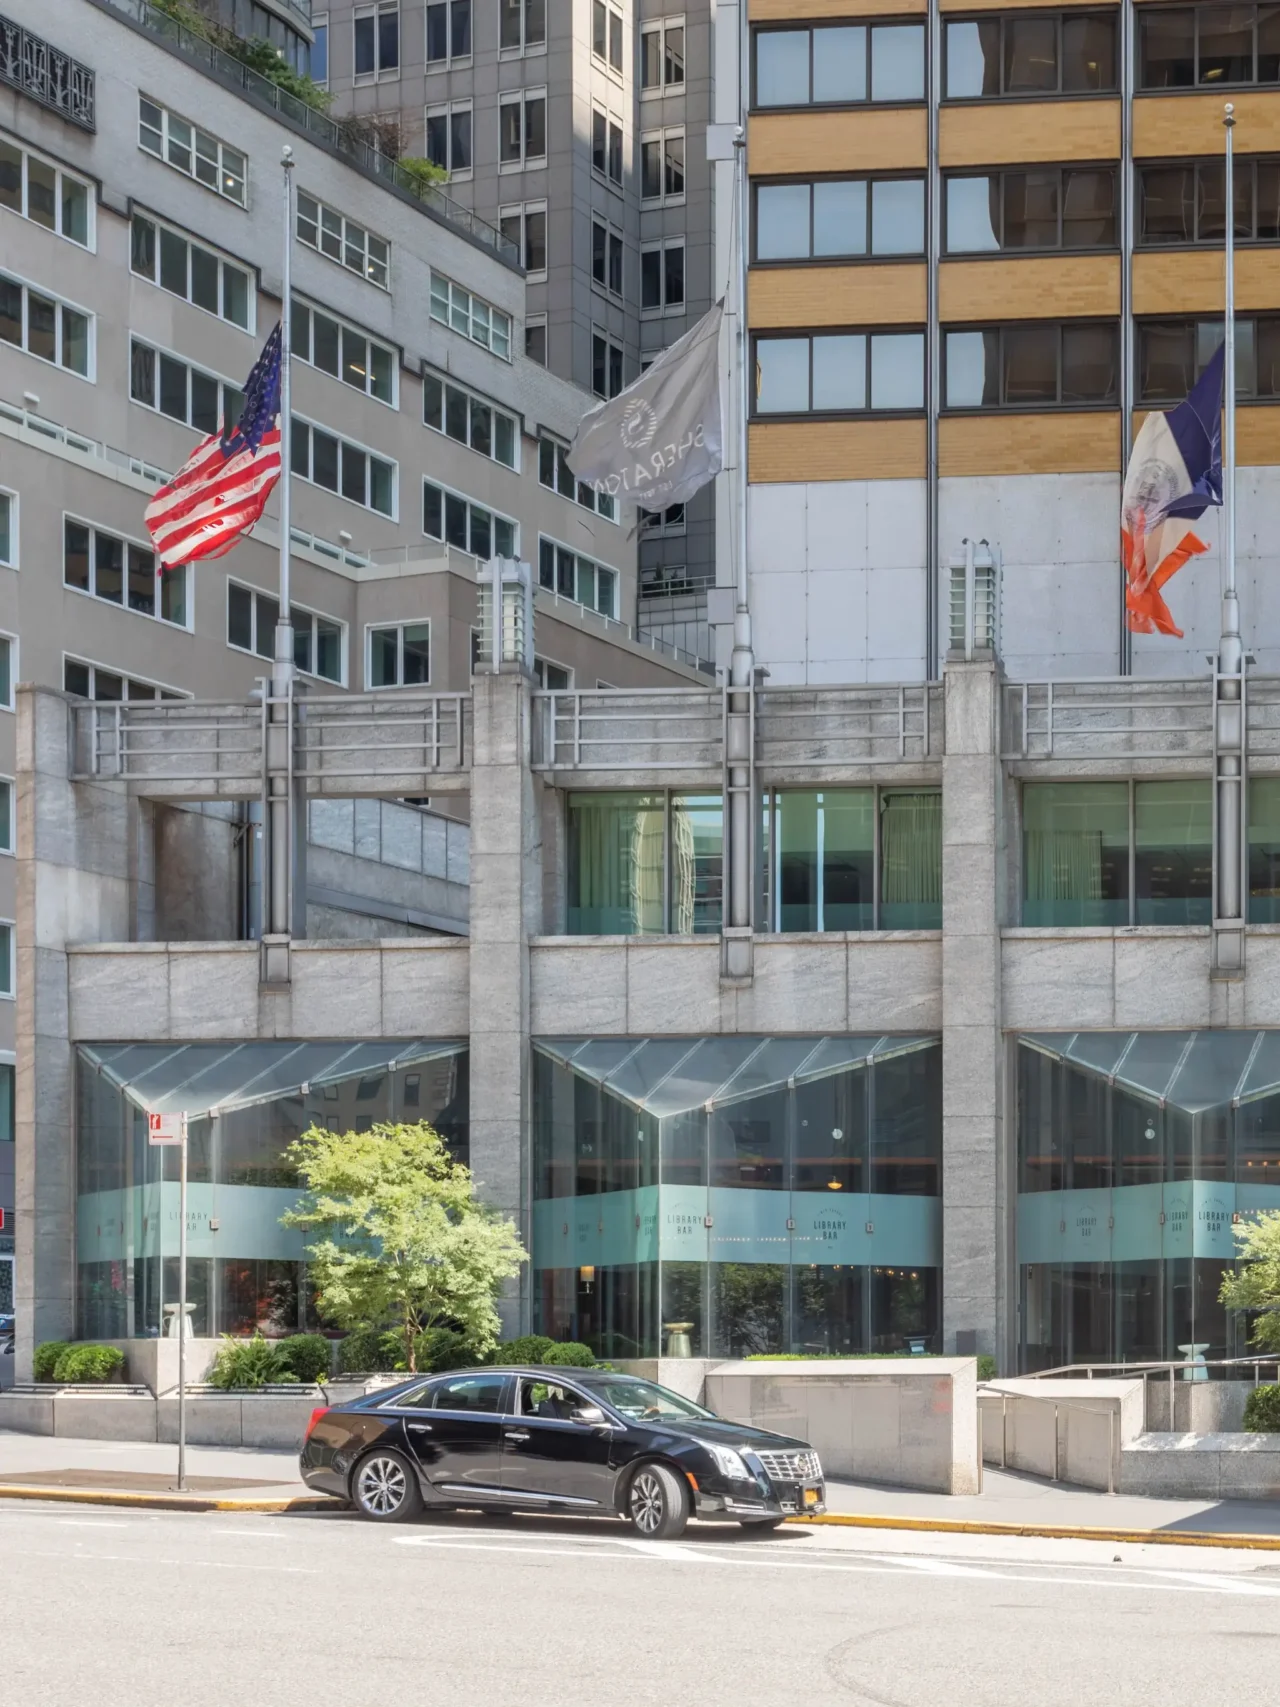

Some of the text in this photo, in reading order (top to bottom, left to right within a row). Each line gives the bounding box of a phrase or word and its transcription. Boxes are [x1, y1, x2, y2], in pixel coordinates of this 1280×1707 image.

[170, 1211, 207, 1220] LIRARY
[667, 1214, 702, 1225] LIBRARY
[1198, 1211, 1230, 1221] LIBRARY
[813, 1220, 847, 1230] LIBRARY
[1207, 1222, 1221, 1232] BAR
[677, 1226, 693, 1235] BAR
[822, 1231, 838, 1240] BAR
